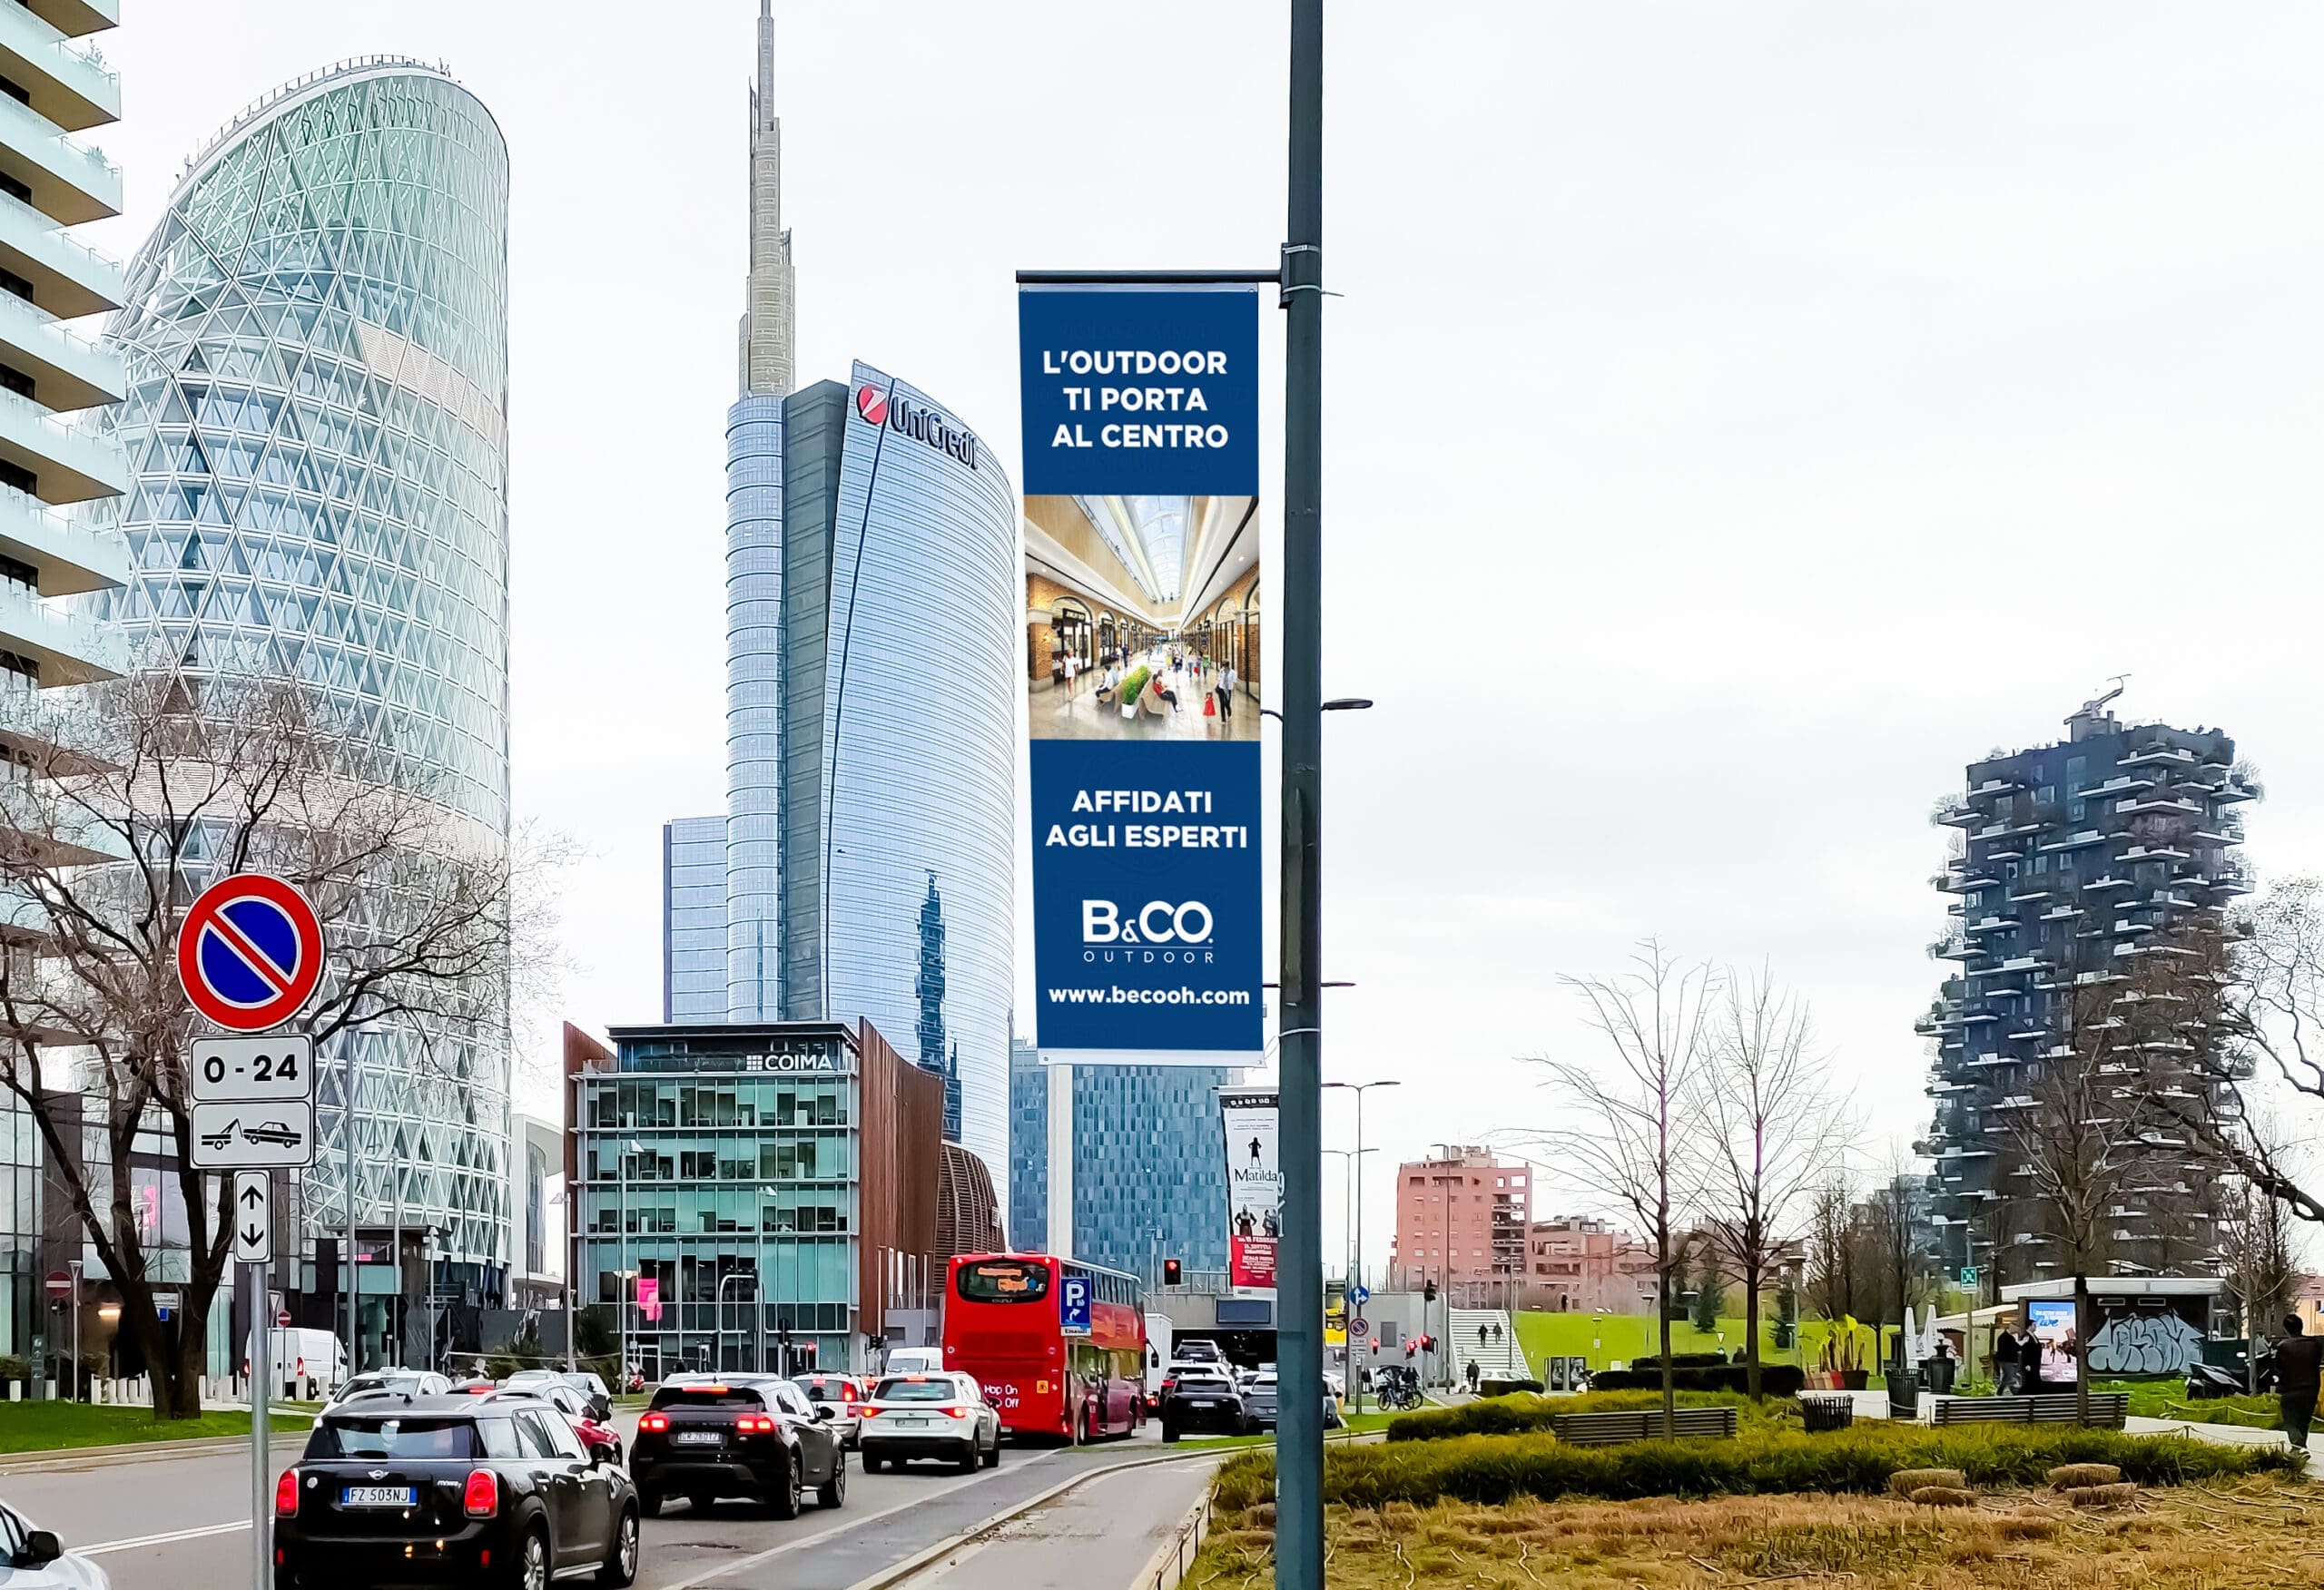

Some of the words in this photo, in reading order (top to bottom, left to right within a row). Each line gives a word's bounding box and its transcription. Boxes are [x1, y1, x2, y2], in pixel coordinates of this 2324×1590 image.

[1043, 351, 1227, 375] L'OUTDOOR
[1063, 388, 1091, 411] TI
[1101, 388, 1208, 411] PORTA
[1051, 424, 1093, 447] AL
[1101, 424, 1229, 448] CENTRO
[1071, 790, 1212, 813] AFFIDATI
[1045, 824, 1116, 847] AGLI
[1125, 825, 1247, 849] ESPERTI
[1083, 950, 1214, 964] OUTDOOR
[1049, 986, 1250, 1005] www.becooh.com
[252, 1054, 299, 1082] 24
[764, 1054, 833, 1070] COIMA
[1235, 1168, 1277, 1183] Matilda
[984, 1384, 1003, 1396] Hop
[1005, 1384, 1019, 1395] On
[1004, 1397, 1019, 1408] Off
[350, 1488, 365, 1501] FZ
[369, 1488, 408, 1501] 503NJ
